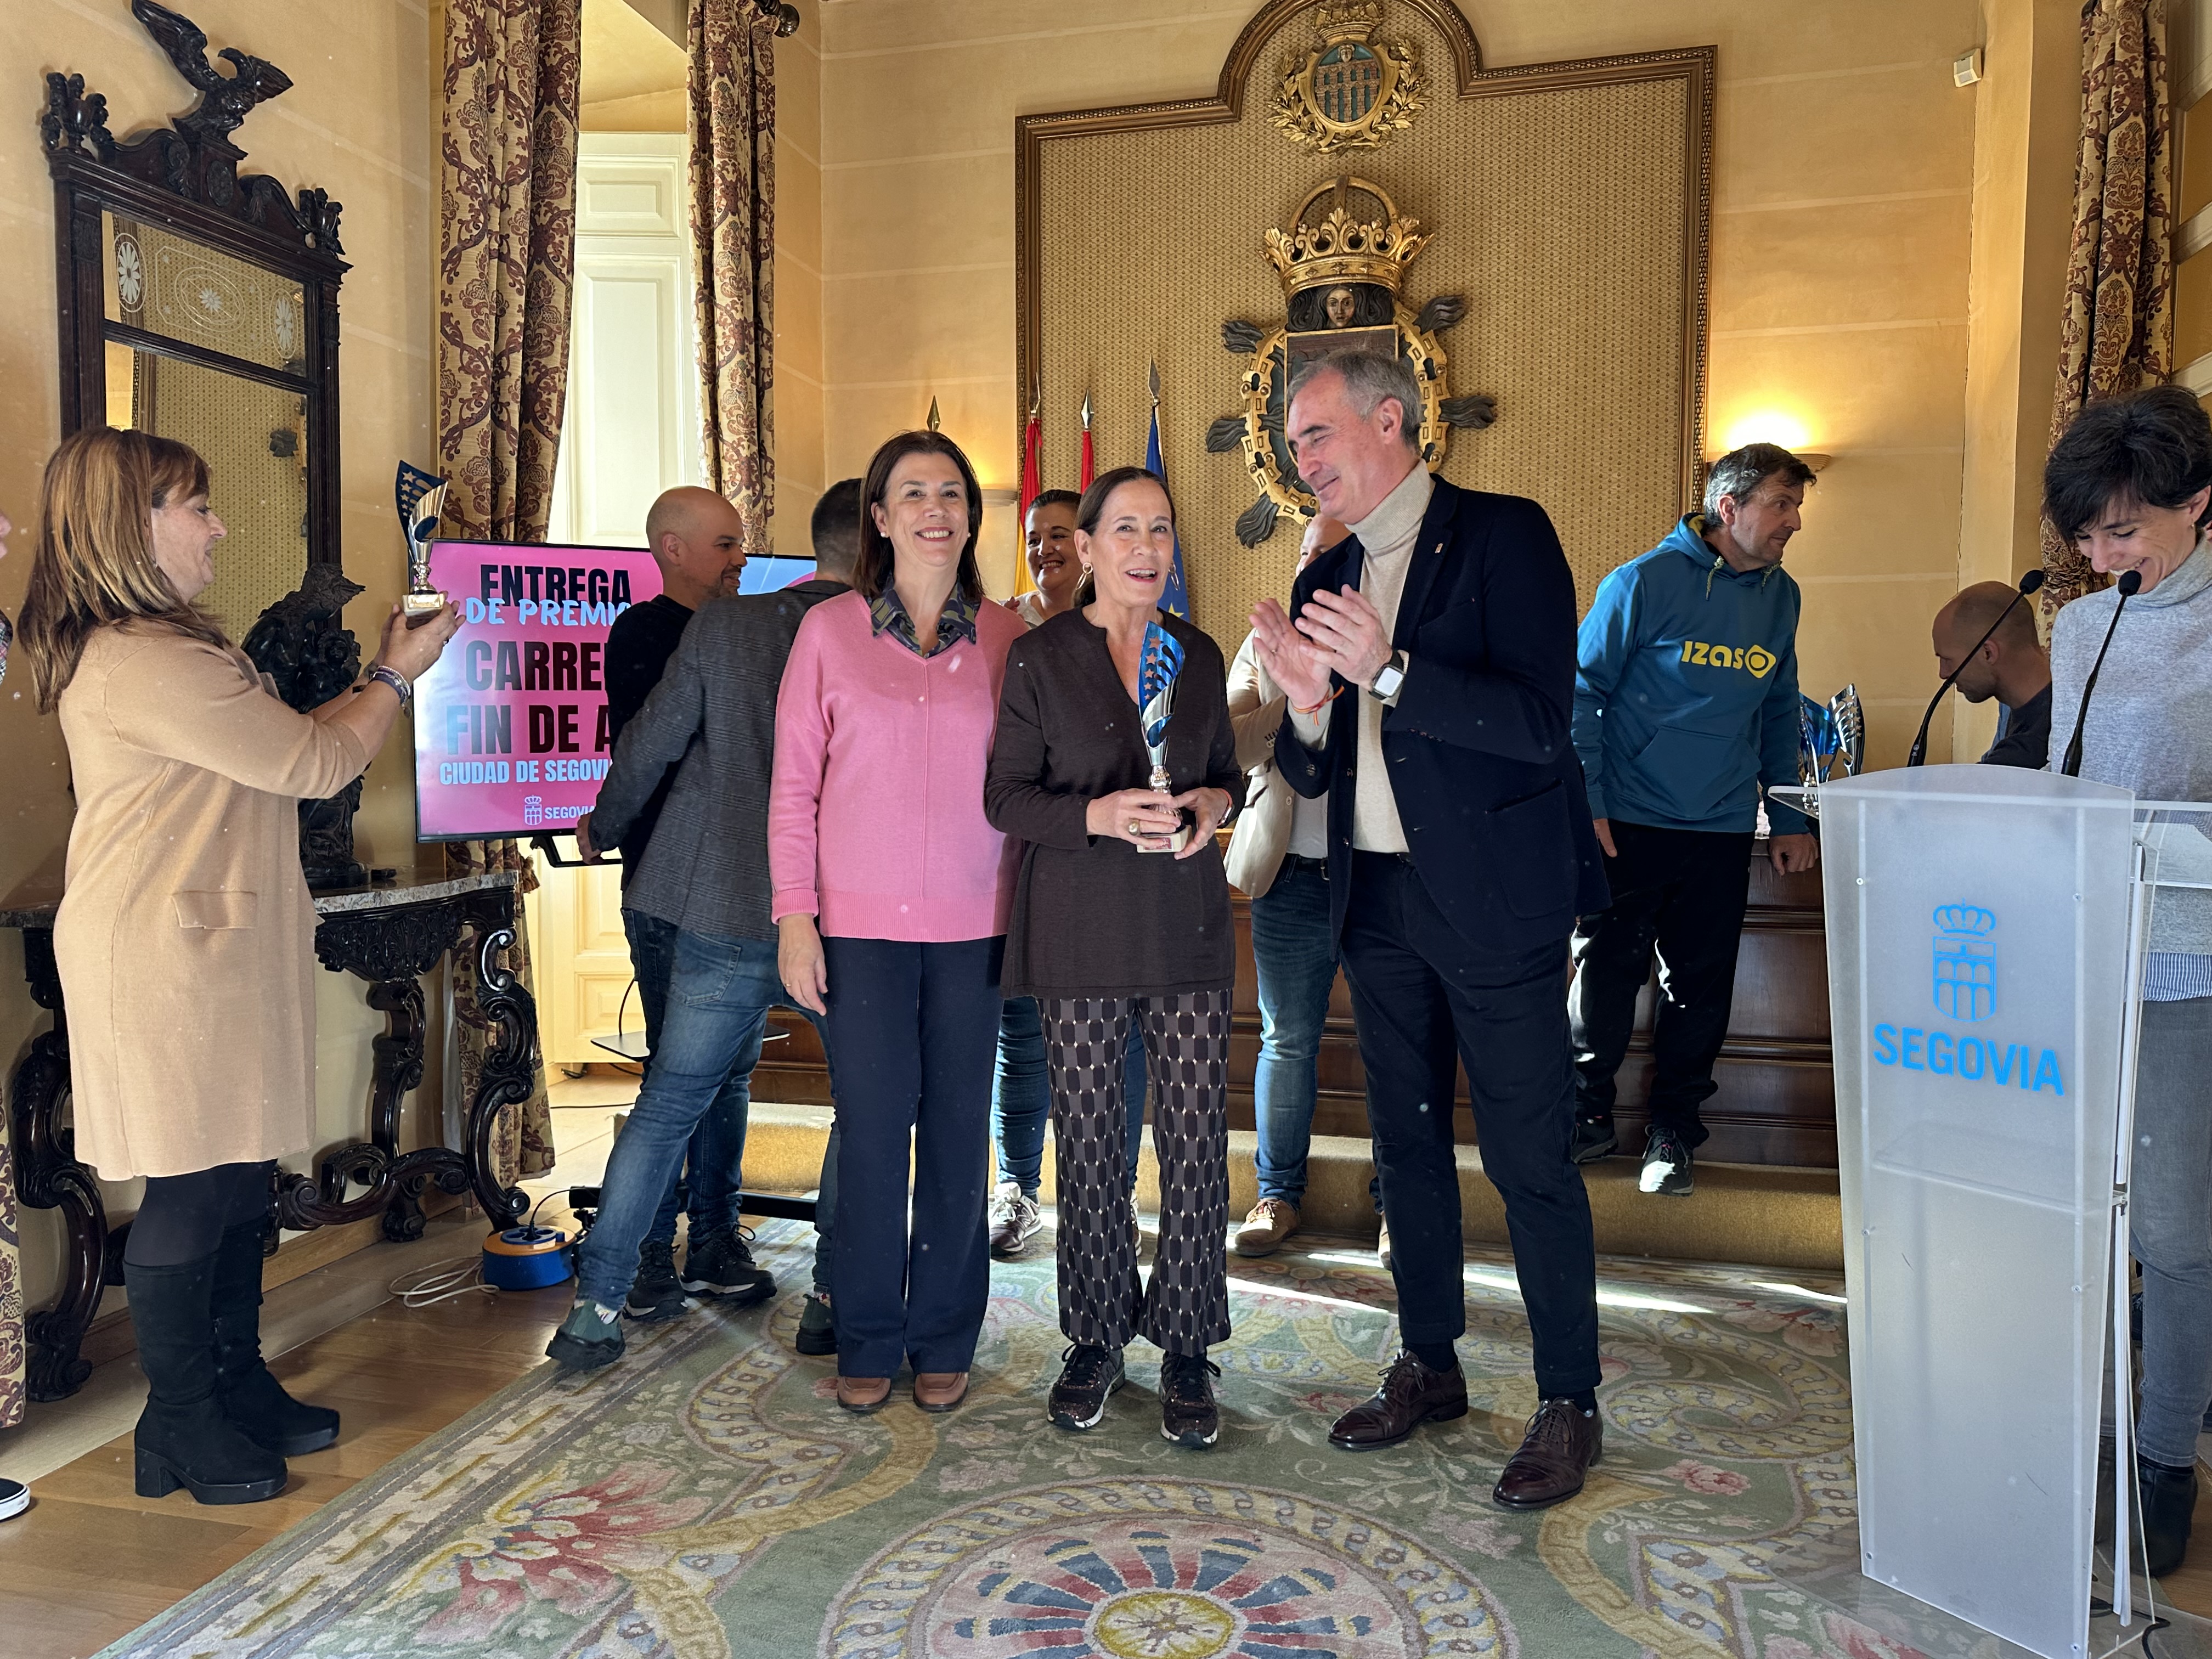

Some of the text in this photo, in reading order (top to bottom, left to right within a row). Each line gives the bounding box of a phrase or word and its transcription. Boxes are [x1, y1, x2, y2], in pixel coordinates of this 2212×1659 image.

[466, 597, 505, 624] DE
[480, 564, 632, 610] ENTREGA
[465, 640, 608, 691] CARRE
[446, 704, 512, 755] FIN
[528, 704, 580, 754] DE
[439, 758, 613, 785] CIUDAD DE SEGOVI
[1872, 1023, 2065, 1097] SEGOVIA
